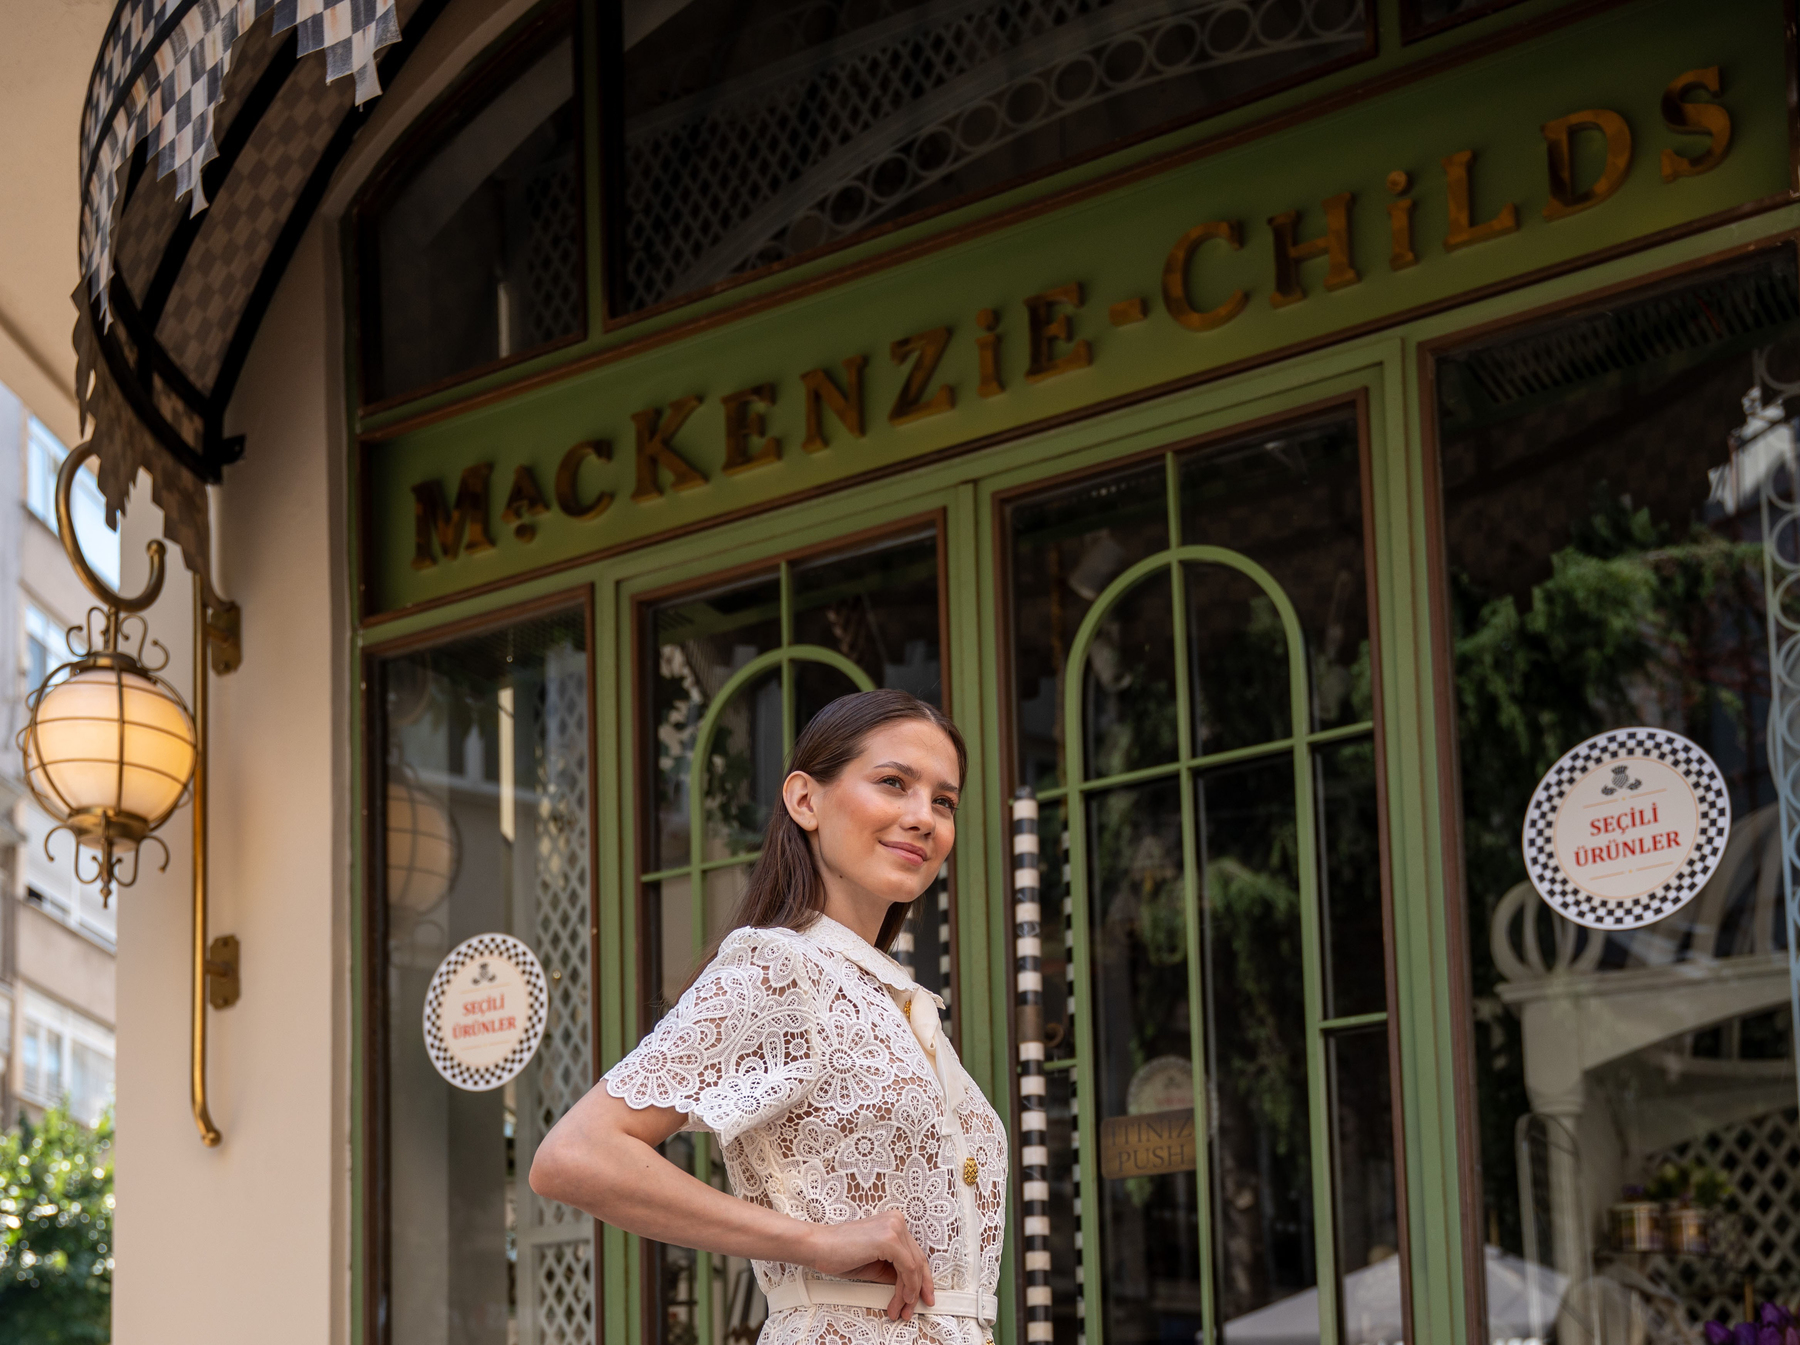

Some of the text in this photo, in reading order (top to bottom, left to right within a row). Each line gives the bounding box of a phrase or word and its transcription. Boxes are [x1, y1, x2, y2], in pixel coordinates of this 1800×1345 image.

[1589, 802, 1659, 837] SEÇİLİ
[1574, 830, 1682, 867] ÜRÜNLER
[462, 993, 505, 1017] SEÇİLİ
[452, 1016, 517, 1040] ÜRÜNLER
[1117, 1144, 1186, 1173] PUSH
